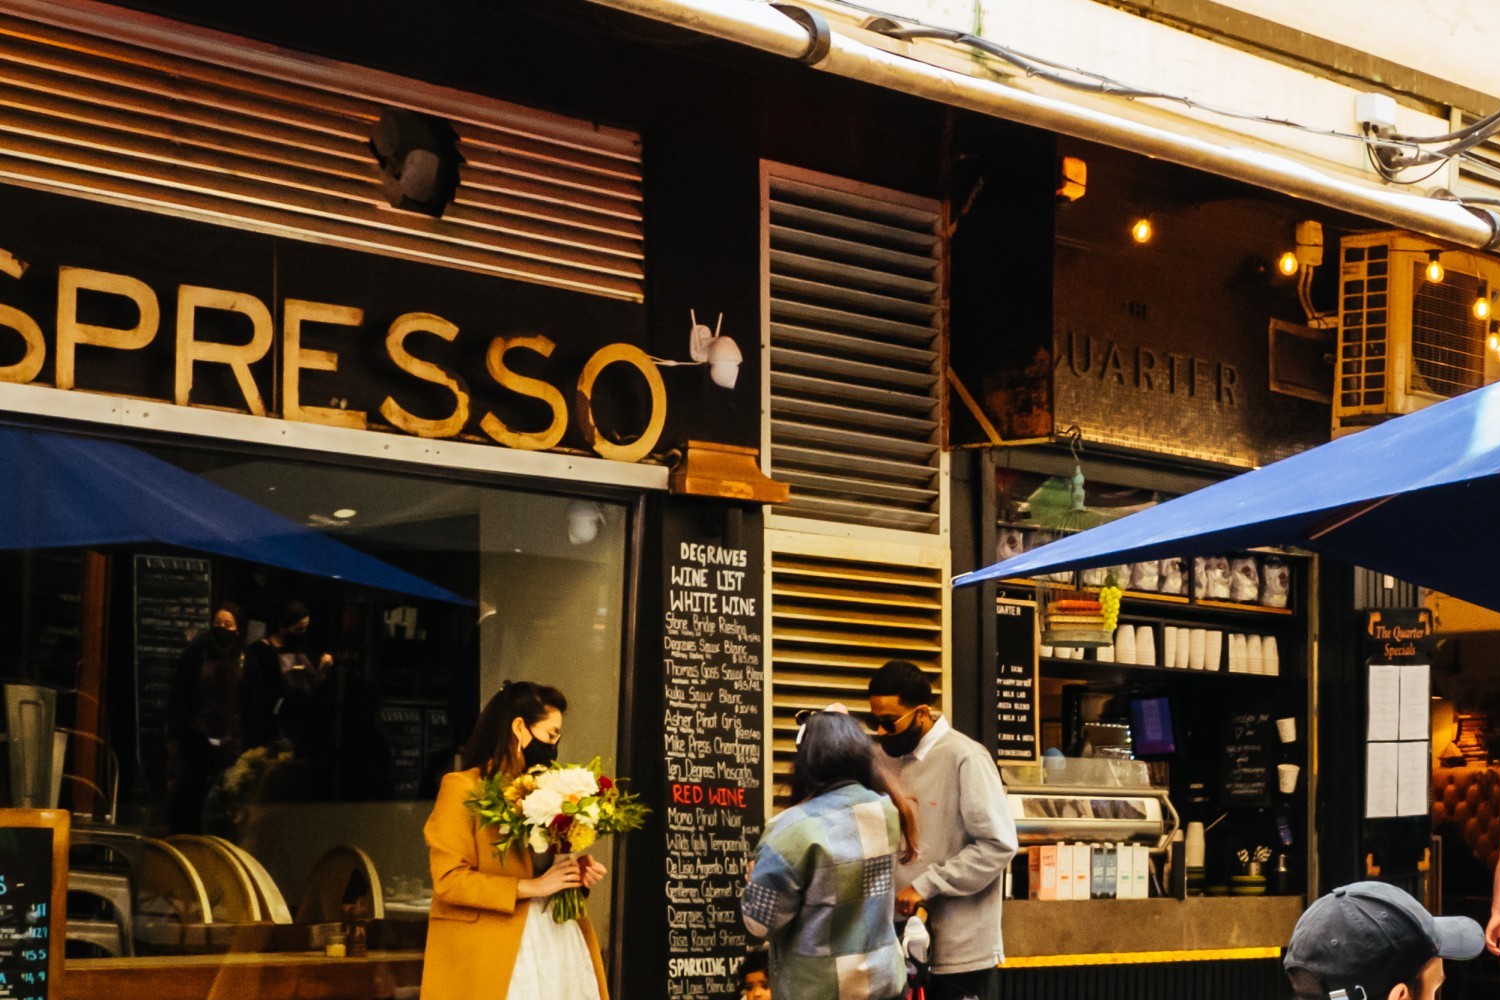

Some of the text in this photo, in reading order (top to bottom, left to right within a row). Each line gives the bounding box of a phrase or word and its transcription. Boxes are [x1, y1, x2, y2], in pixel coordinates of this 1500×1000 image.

[1054, 330, 1239, 406] UARTER
[680, 542, 747, 567] DEGRAVES
[671, 565, 745, 591] WINE LIST
[670, 589, 756, 616] WHITE WINE
[997, 604, 1021, 616] UARTER
[665, 611, 688, 630] Stone
[693, 613, 716, 636] Bridge
[1376, 625, 1424, 642] The Quarter
[724, 640, 748, 655] Blanc
[1384, 642, 1416, 661] Specials
[664, 659, 699, 678] Thomas
[719, 688, 743, 704] Blanc
[696, 710, 717, 729] Pinot
[722, 712, 742, 731] Gris
[664, 733, 685, 752] Mike
[672, 784, 747, 808] RED WINE
[696, 807, 717, 827] Pinot
[707, 904, 736, 924] Shiraz
[668, 956, 727, 977] SPARKLING
